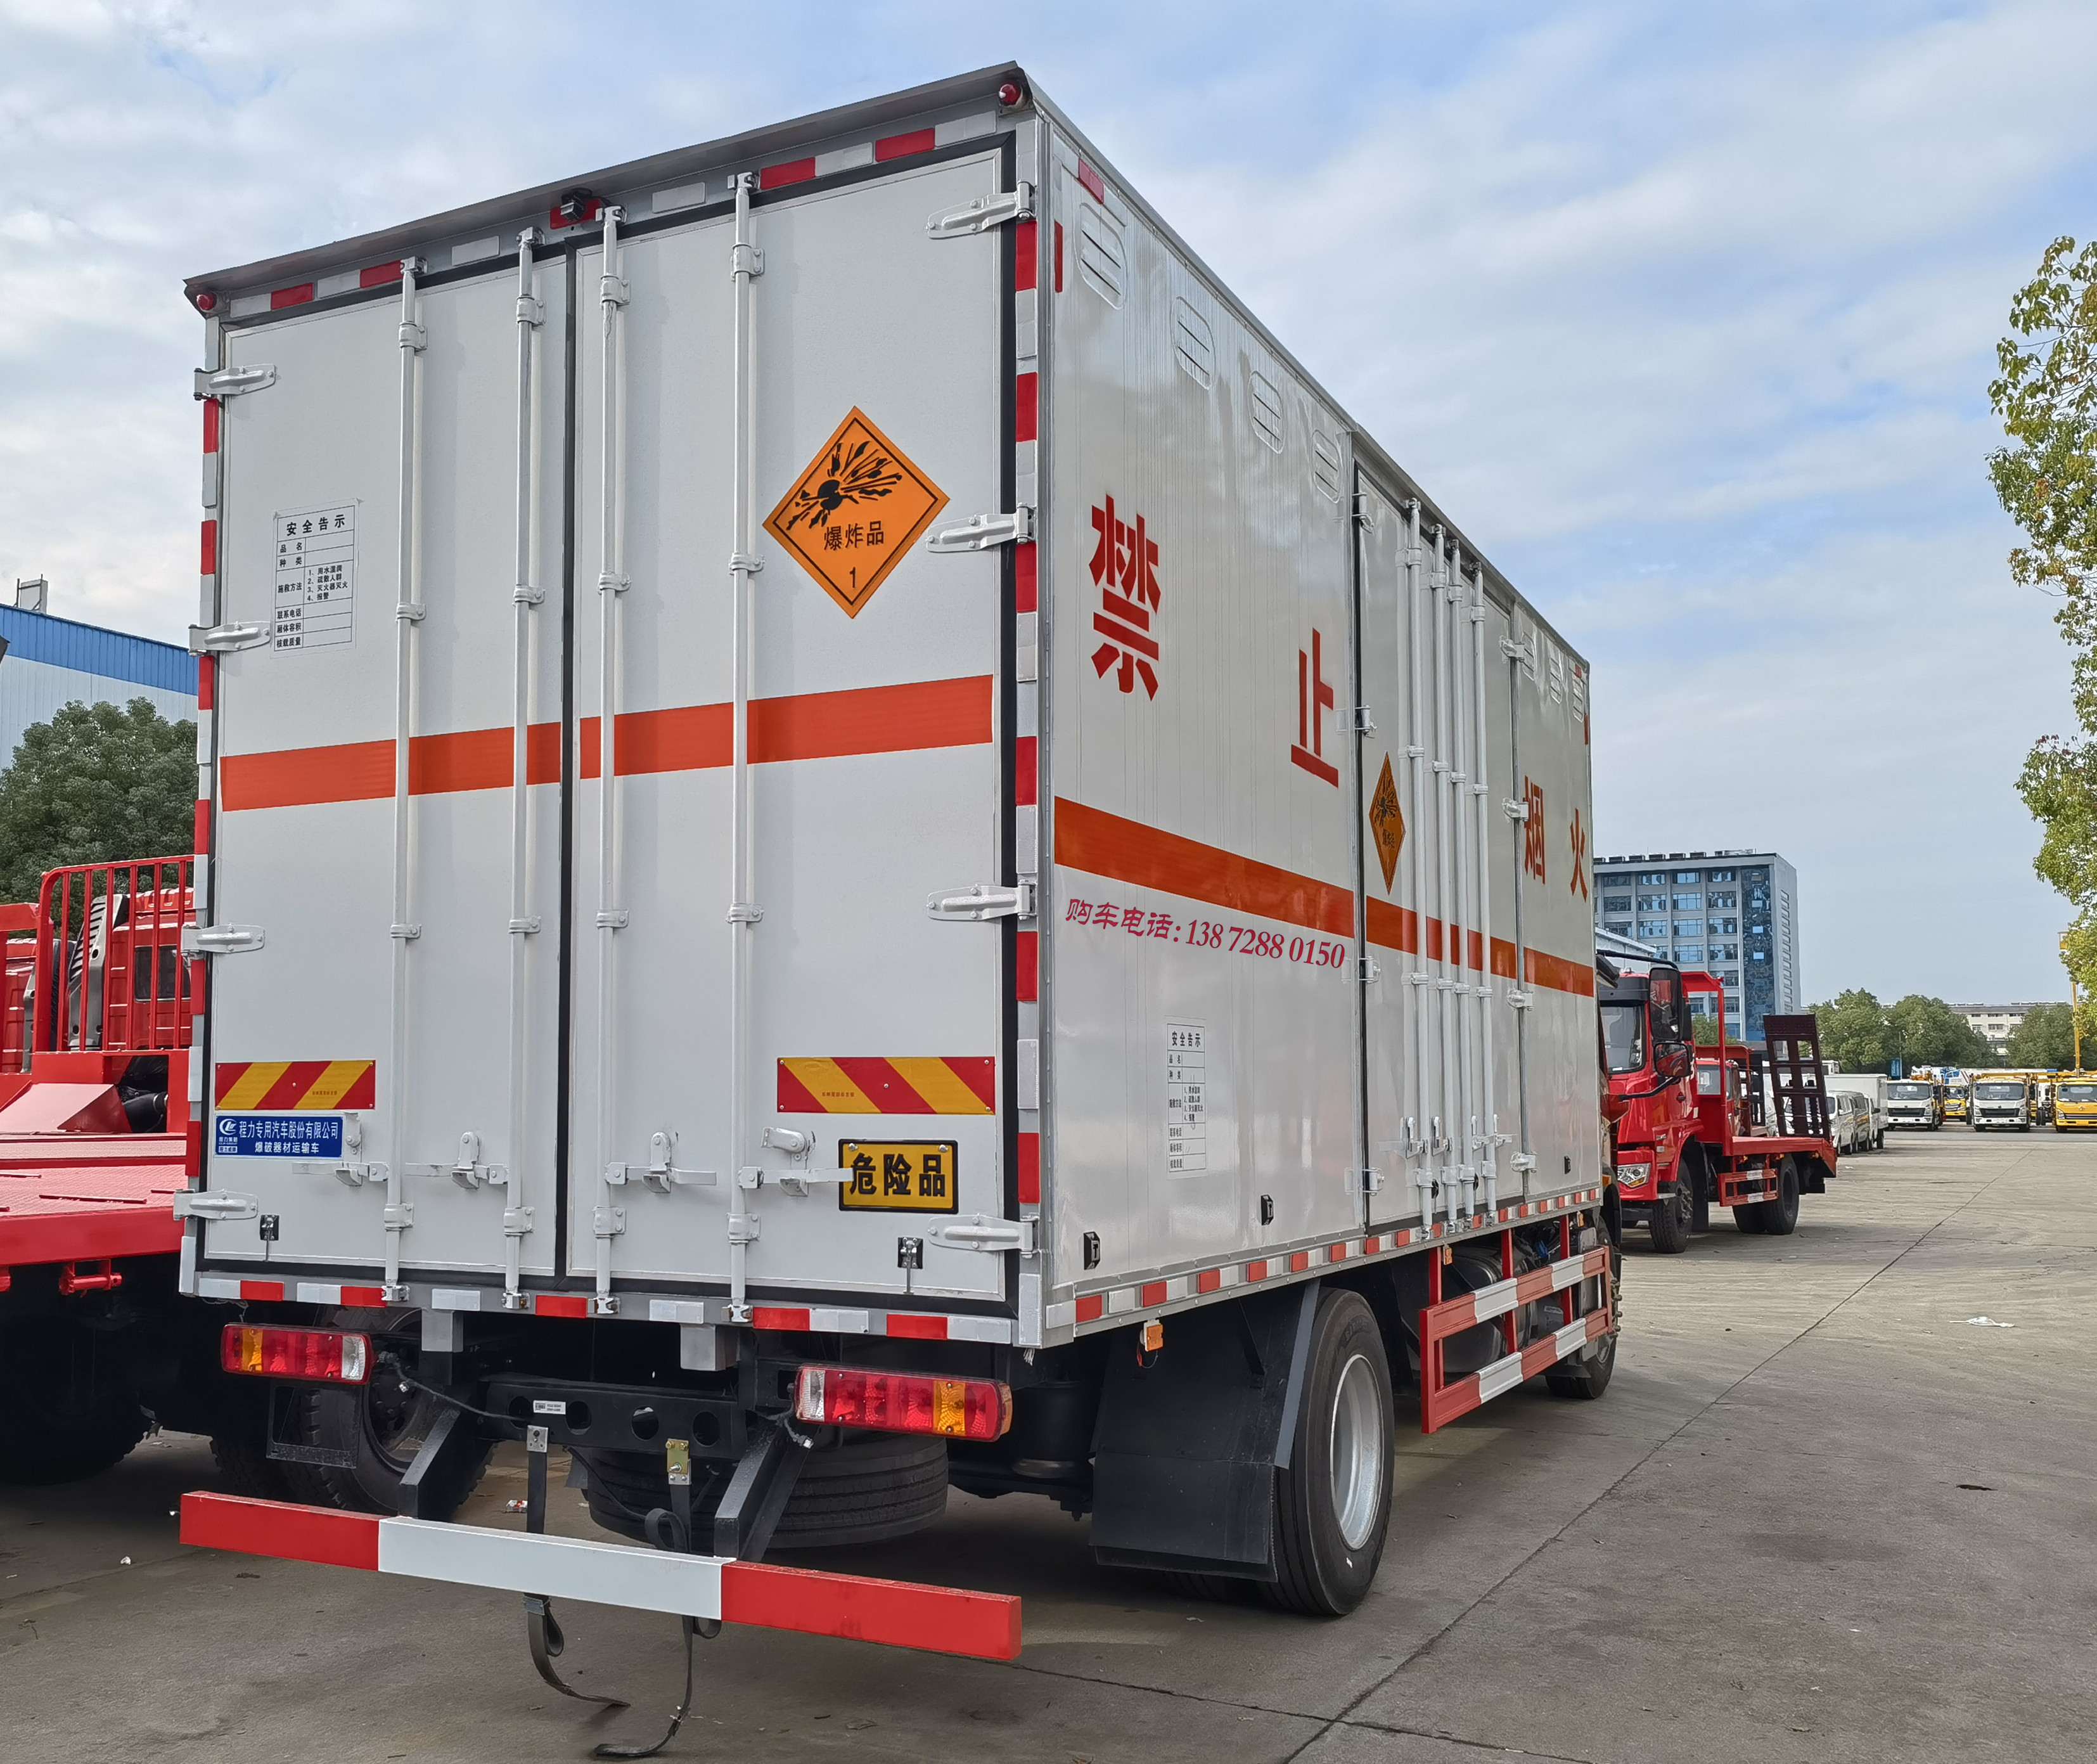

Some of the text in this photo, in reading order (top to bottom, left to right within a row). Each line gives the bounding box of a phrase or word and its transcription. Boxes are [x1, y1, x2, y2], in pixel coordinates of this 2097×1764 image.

[286, 514, 345, 536] 安全告示
[824, 520, 884, 551] 爆炸品
[849, 567, 856, 588] 1
[1089, 494, 1161, 702] 禁
[1291, 628, 1339, 789] 止
[1172, 1031, 1201, 1047] 安全告示
[239, 1120, 338, 1139] 程力专用汽车股份有限公司
[255, 1142, 319, 1154] 爆破器材运输车
[850, 1152, 946, 1197] 危险品
